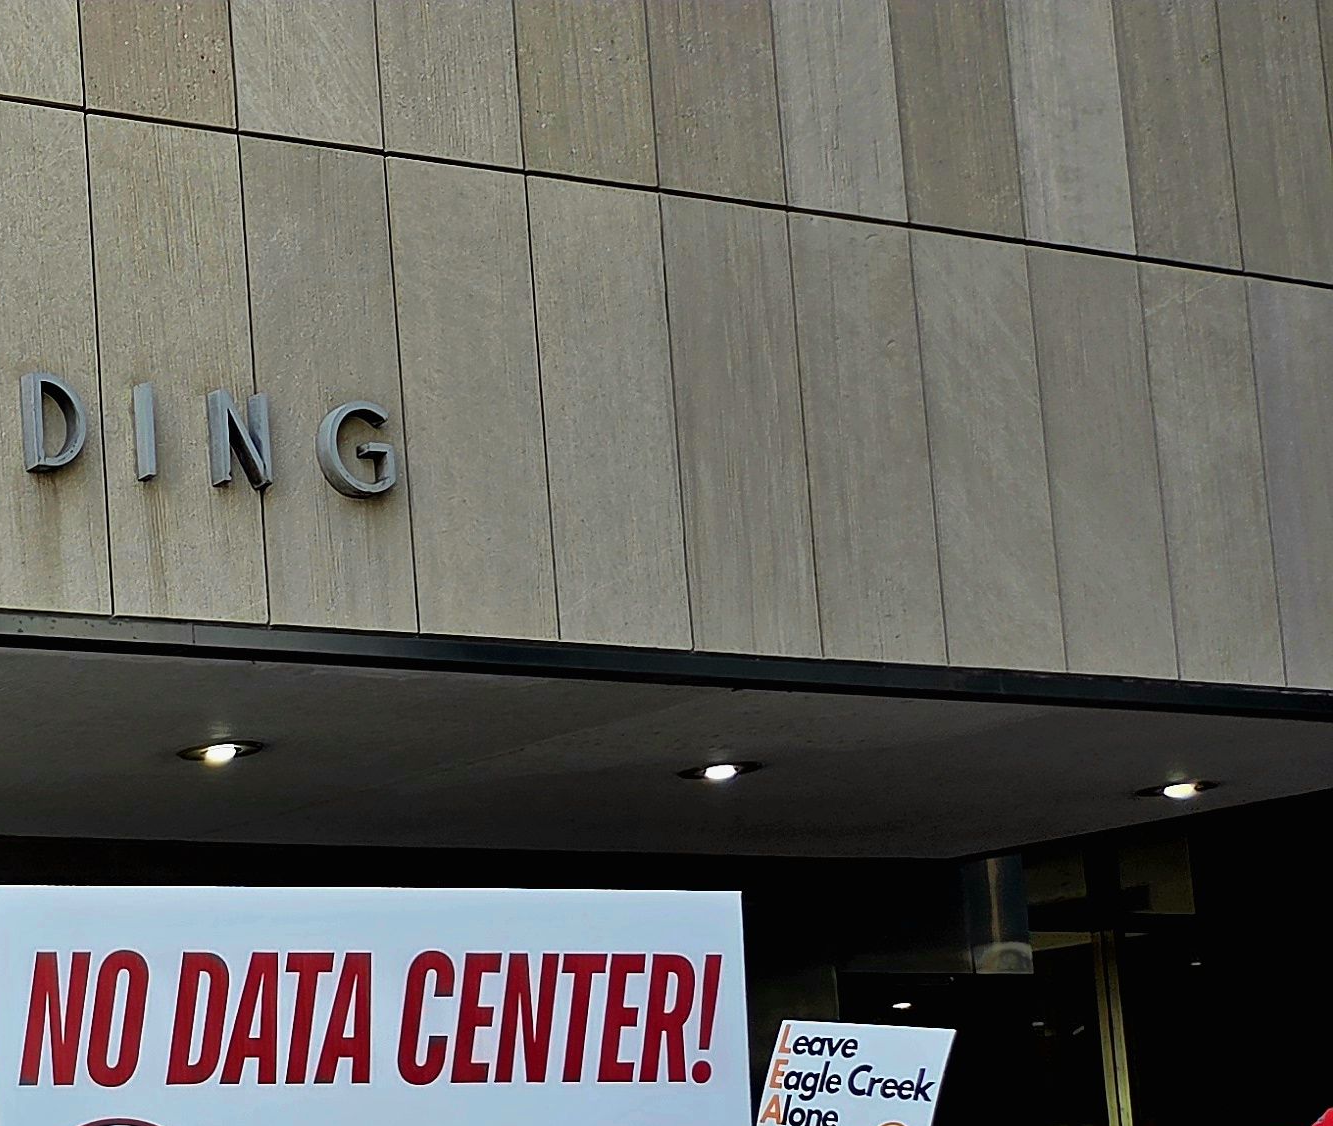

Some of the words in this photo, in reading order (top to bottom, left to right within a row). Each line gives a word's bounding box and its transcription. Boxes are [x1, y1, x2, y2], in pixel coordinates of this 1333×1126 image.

[19, 949, 150, 1087] NO
[166, 951, 372, 1084] DATA
[397, 950, 722, 1086] CENTER!
[778, 1024, 858, 1058] Leave
[769, 1059, 842, 1100] Eagle
[848, 1065, 935, 1102] Creek
